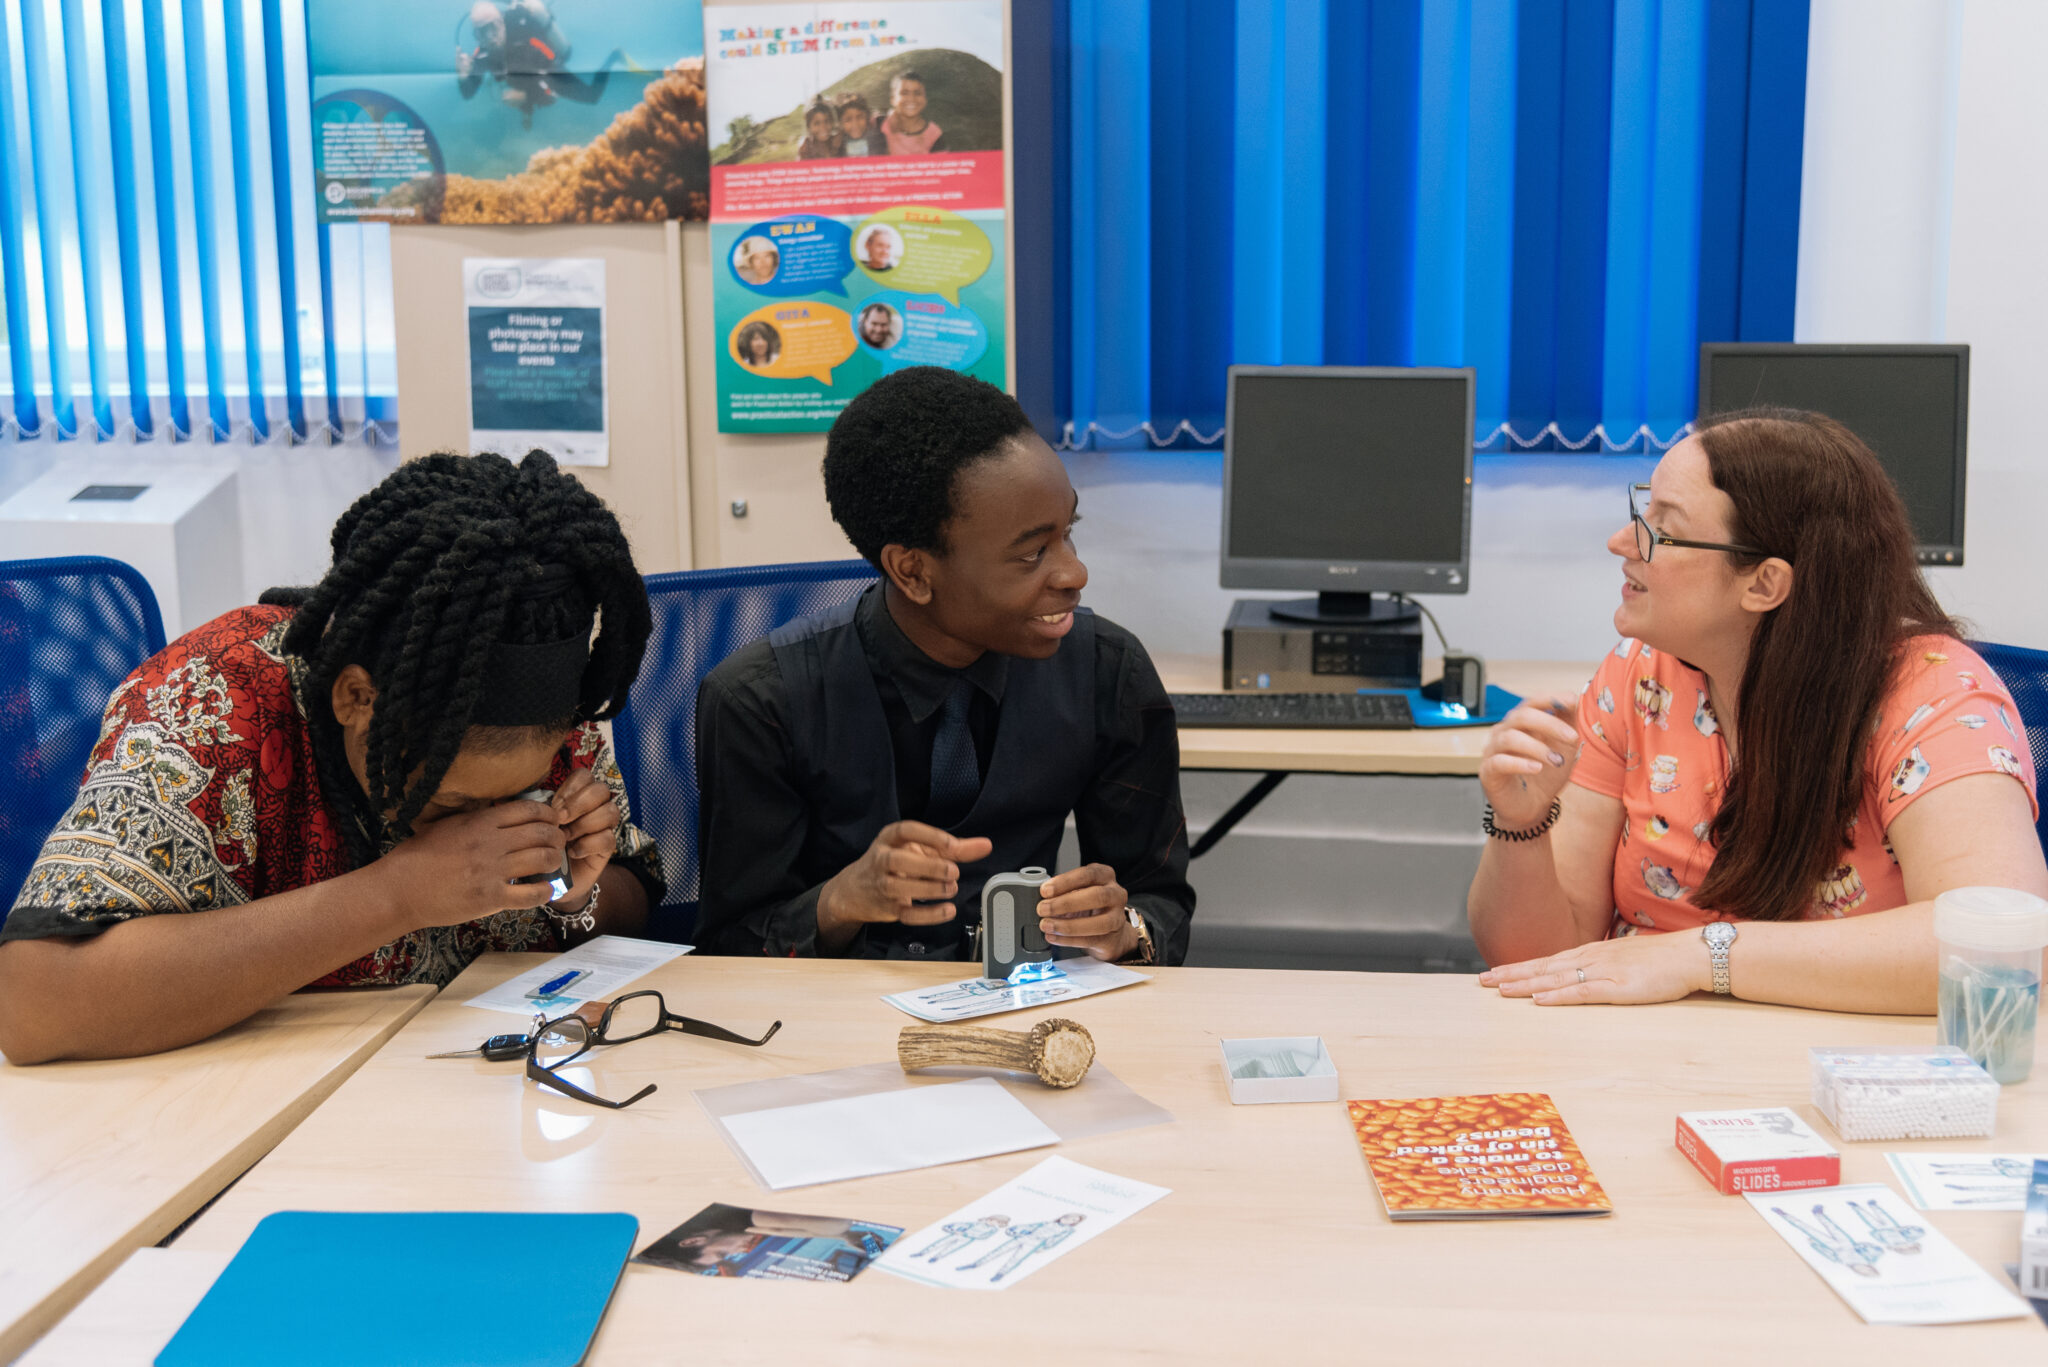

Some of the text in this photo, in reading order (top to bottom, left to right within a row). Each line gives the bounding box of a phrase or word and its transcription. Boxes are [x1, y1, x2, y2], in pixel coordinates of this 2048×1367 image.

[719, 18, 888, 42] Making a difference
[719, 43, 762, 60] could
[766, 37, 819, 56] STEM
[824, 36, 866, 51] from
[508, 314, 562, 328] Filming or
[488, 328, 583, 341] photography may
[492, 341, 581, 354] take place in our
[518, 354, 556, 366] events
[1696, 1117, 1754, 1127] SLIDES
[1454, 1126, 1551, 1143] beans?
[1395, 1138, 1558, 1157] tin of baked
[1431, 1150, 1562, 1165] to make a
[1437, 1162, 1571, 1176] does it take
[1732, 1166, 1776, 1174] MICROSCOPE
[1458, 1174, 1579, 1186] engineers
[1733, 1174, 1781, 1190] SLIDES
[1459, 1184, 1587, 1197] How many
